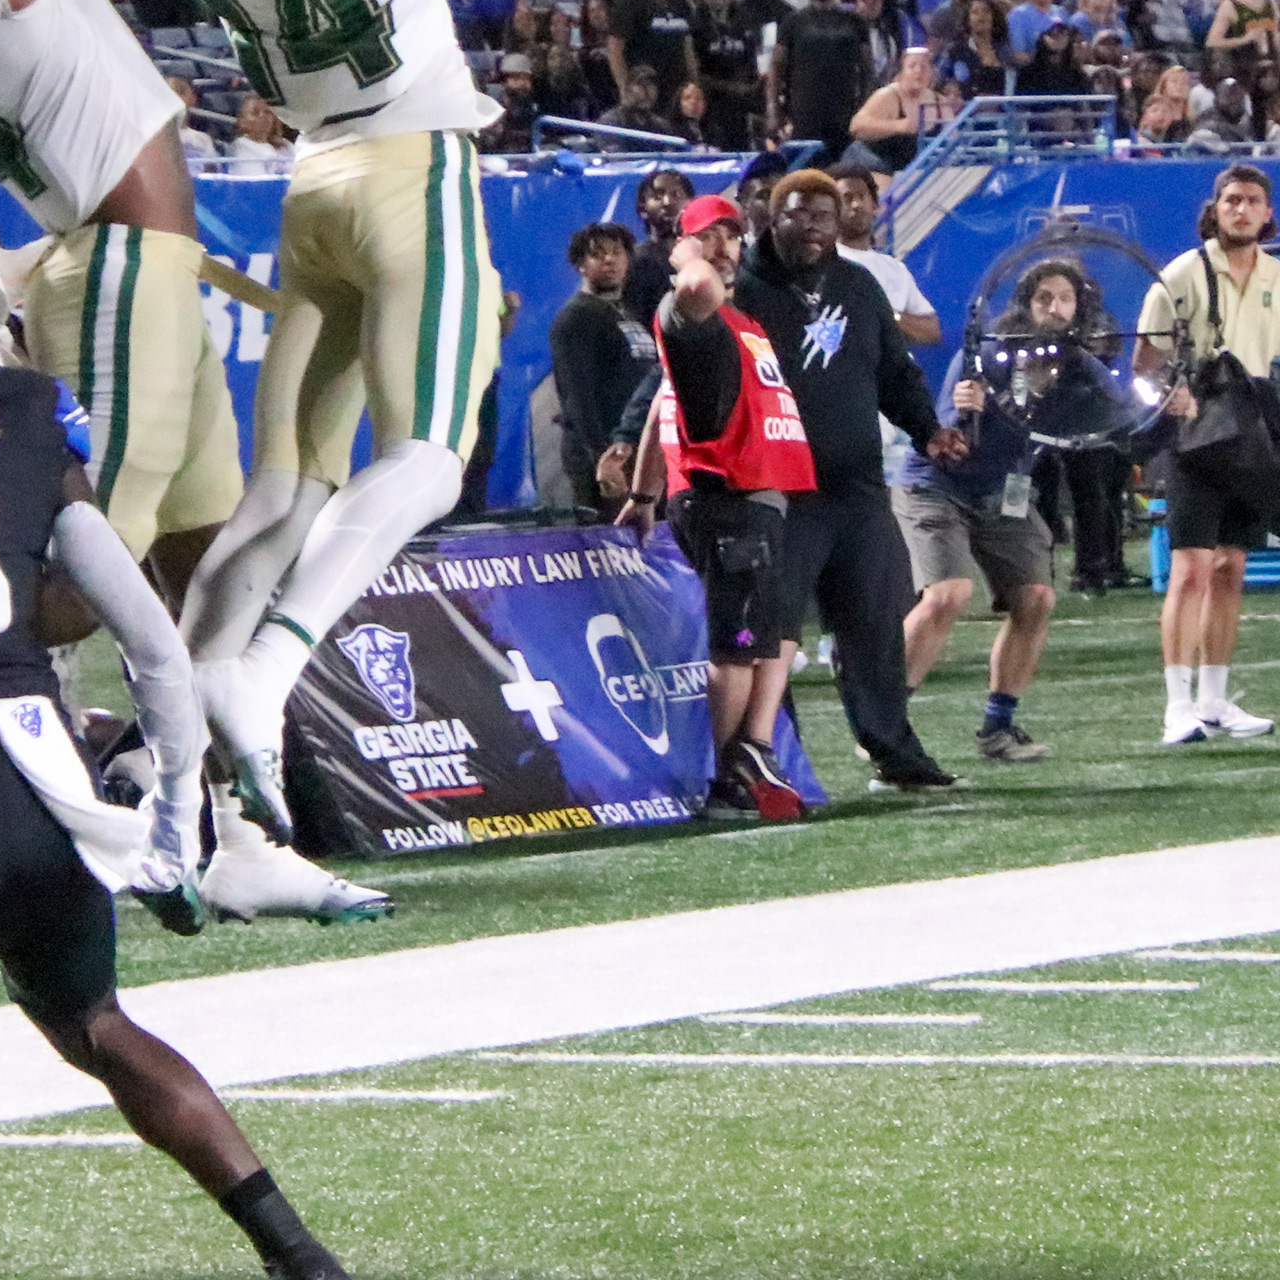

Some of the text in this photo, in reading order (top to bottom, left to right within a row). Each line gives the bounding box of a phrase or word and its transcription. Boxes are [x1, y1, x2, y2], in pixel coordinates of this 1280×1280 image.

[436, 556, 524, 592] INJURY
[527, 550, 584, 584] LAW
[585, 547, 649, 579] FIRM
[353, 718, 478, 761] GEORGIA
[388, 753, 478, 792] STATE
[382, 820, 466, 851] FOLLOW
[467, 806, 597, 843] @CEOLAWYER
[592, 801, 630, 825] FOR
[634, 795, 680, 820] FREE
